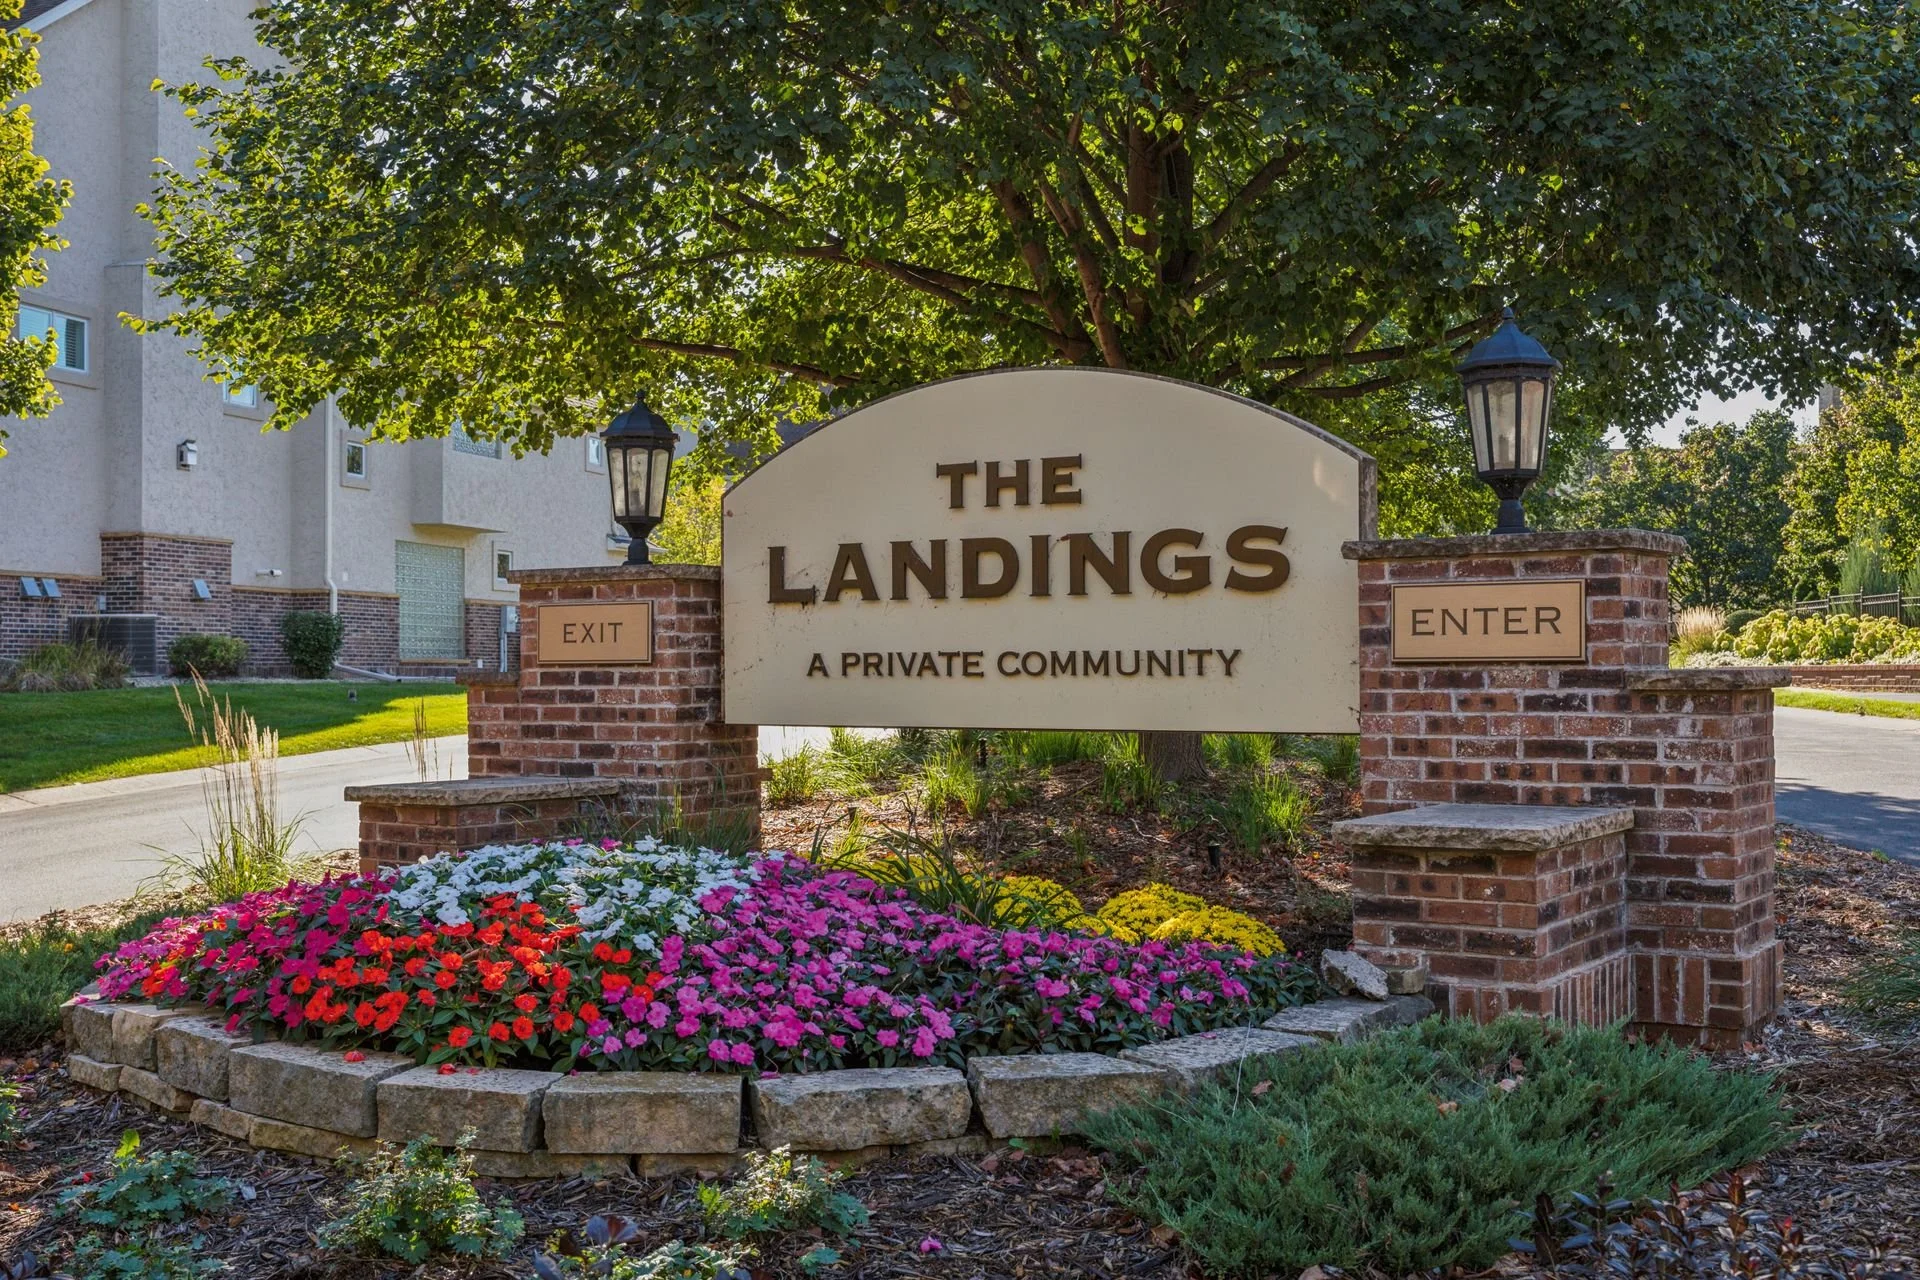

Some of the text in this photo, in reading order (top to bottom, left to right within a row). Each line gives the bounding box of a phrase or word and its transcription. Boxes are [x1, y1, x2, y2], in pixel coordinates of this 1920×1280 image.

[935, 453, 1082, 509] THE
[766, 525, 1291, 603] LANDINGS
[563, 622, 623, 644] EXIT
[1411, 606, 1562, 636] ENTER
[806, 648, 1242, 678] A PRIVATE COMMUNITY
